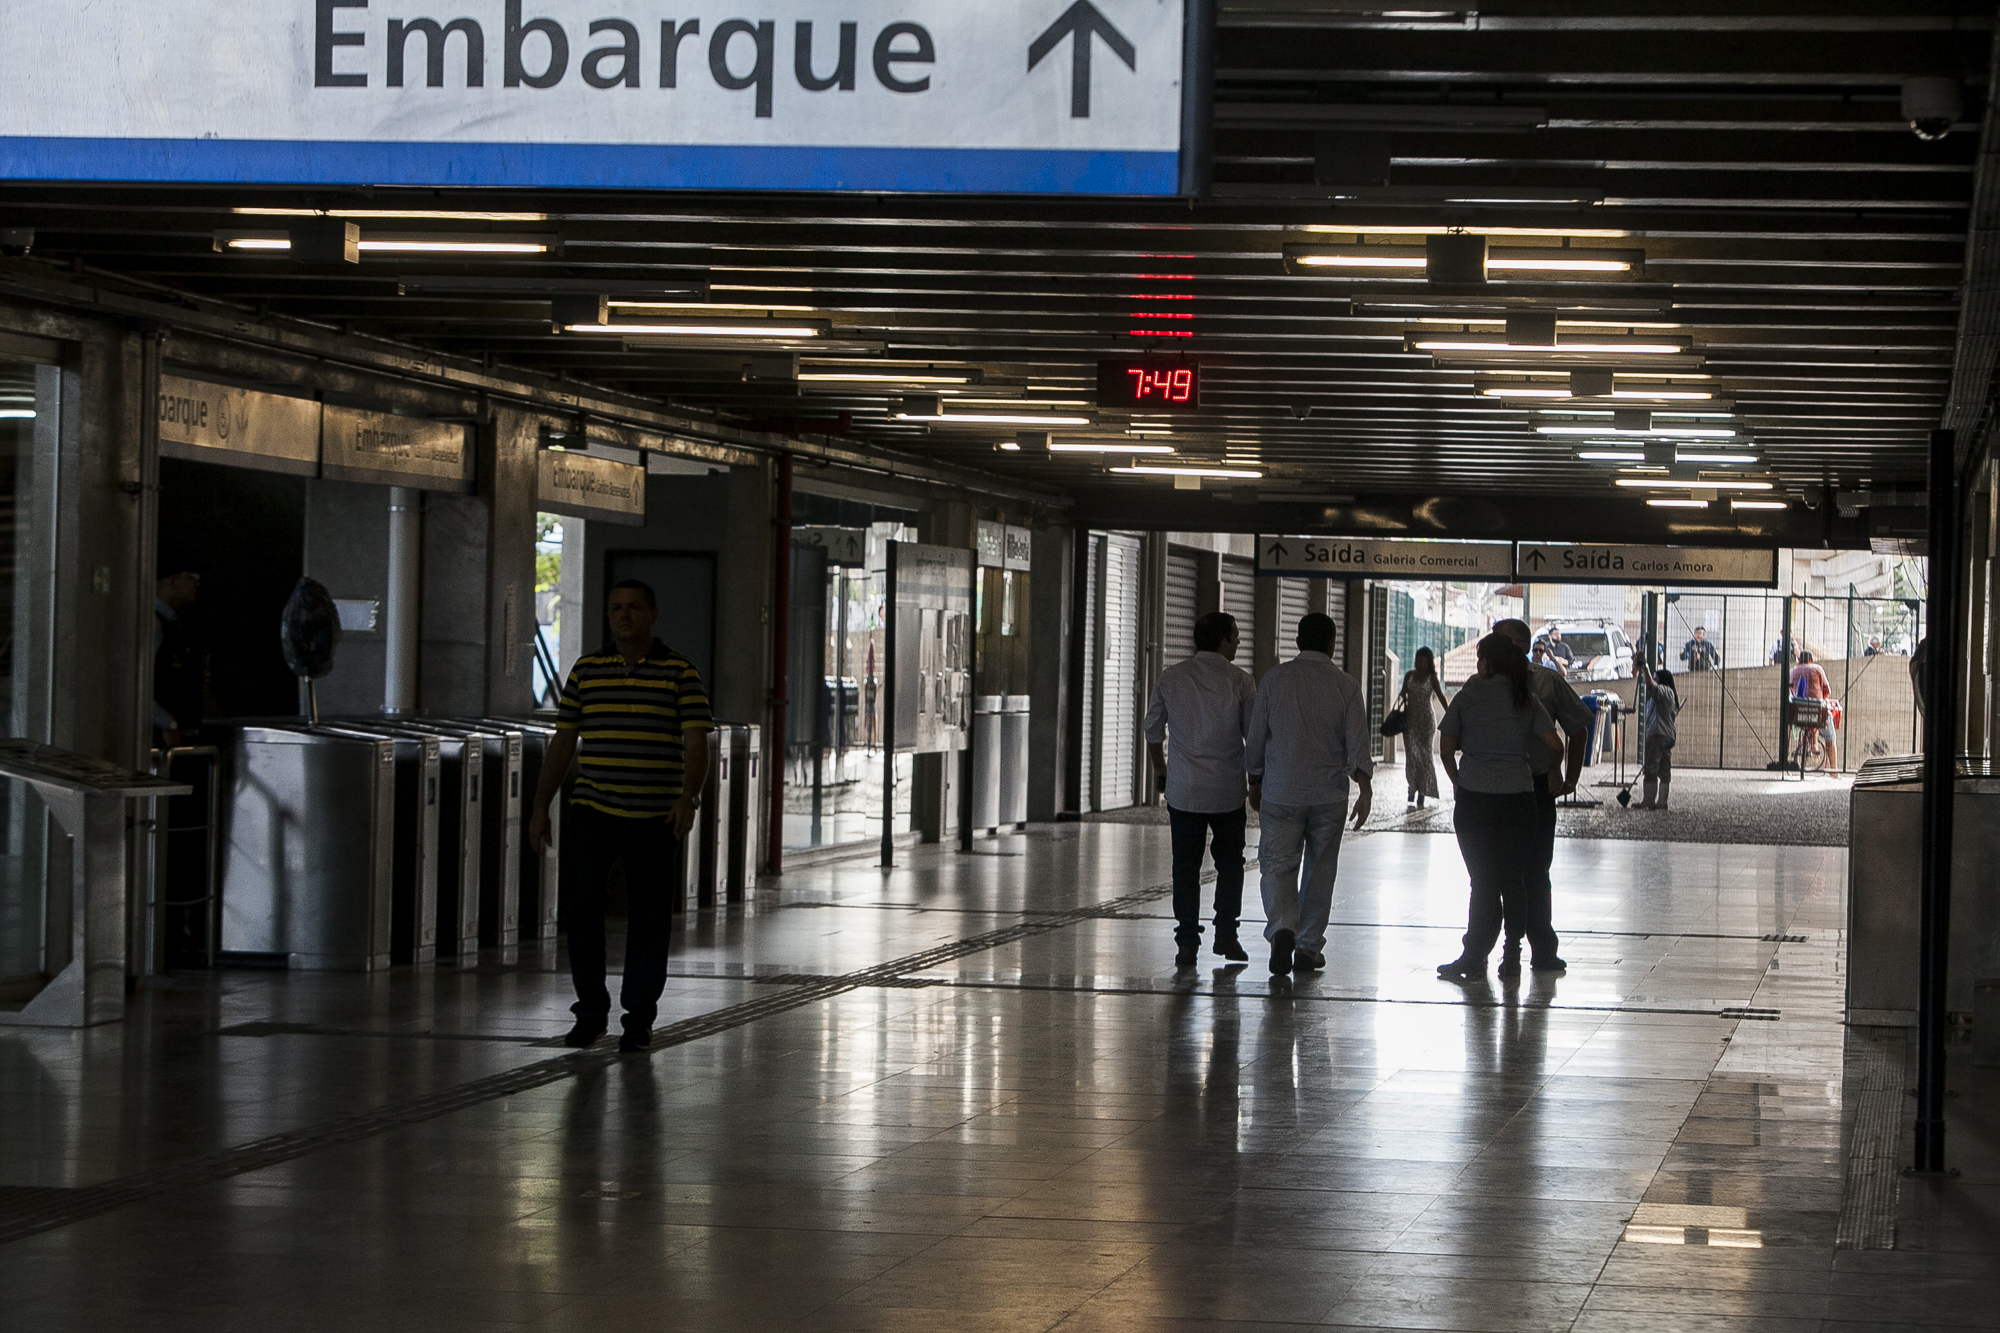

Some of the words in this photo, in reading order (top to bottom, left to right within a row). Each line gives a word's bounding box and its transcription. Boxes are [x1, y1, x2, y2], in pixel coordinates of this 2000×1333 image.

[314, 0, 936, 119] Embarque
[1127, 368, 1192, 402] 7:49
[1304, 543, 1366, 564] Saída
[1373, 554, 1416, 566] Galeria
[1419, 555, 1479, 568] Comercial
[1563, 549, 1625, 571] Saída
[1632, 560, 1669, 572] Carlos
[1673, 561, 1714, 573] Amora
